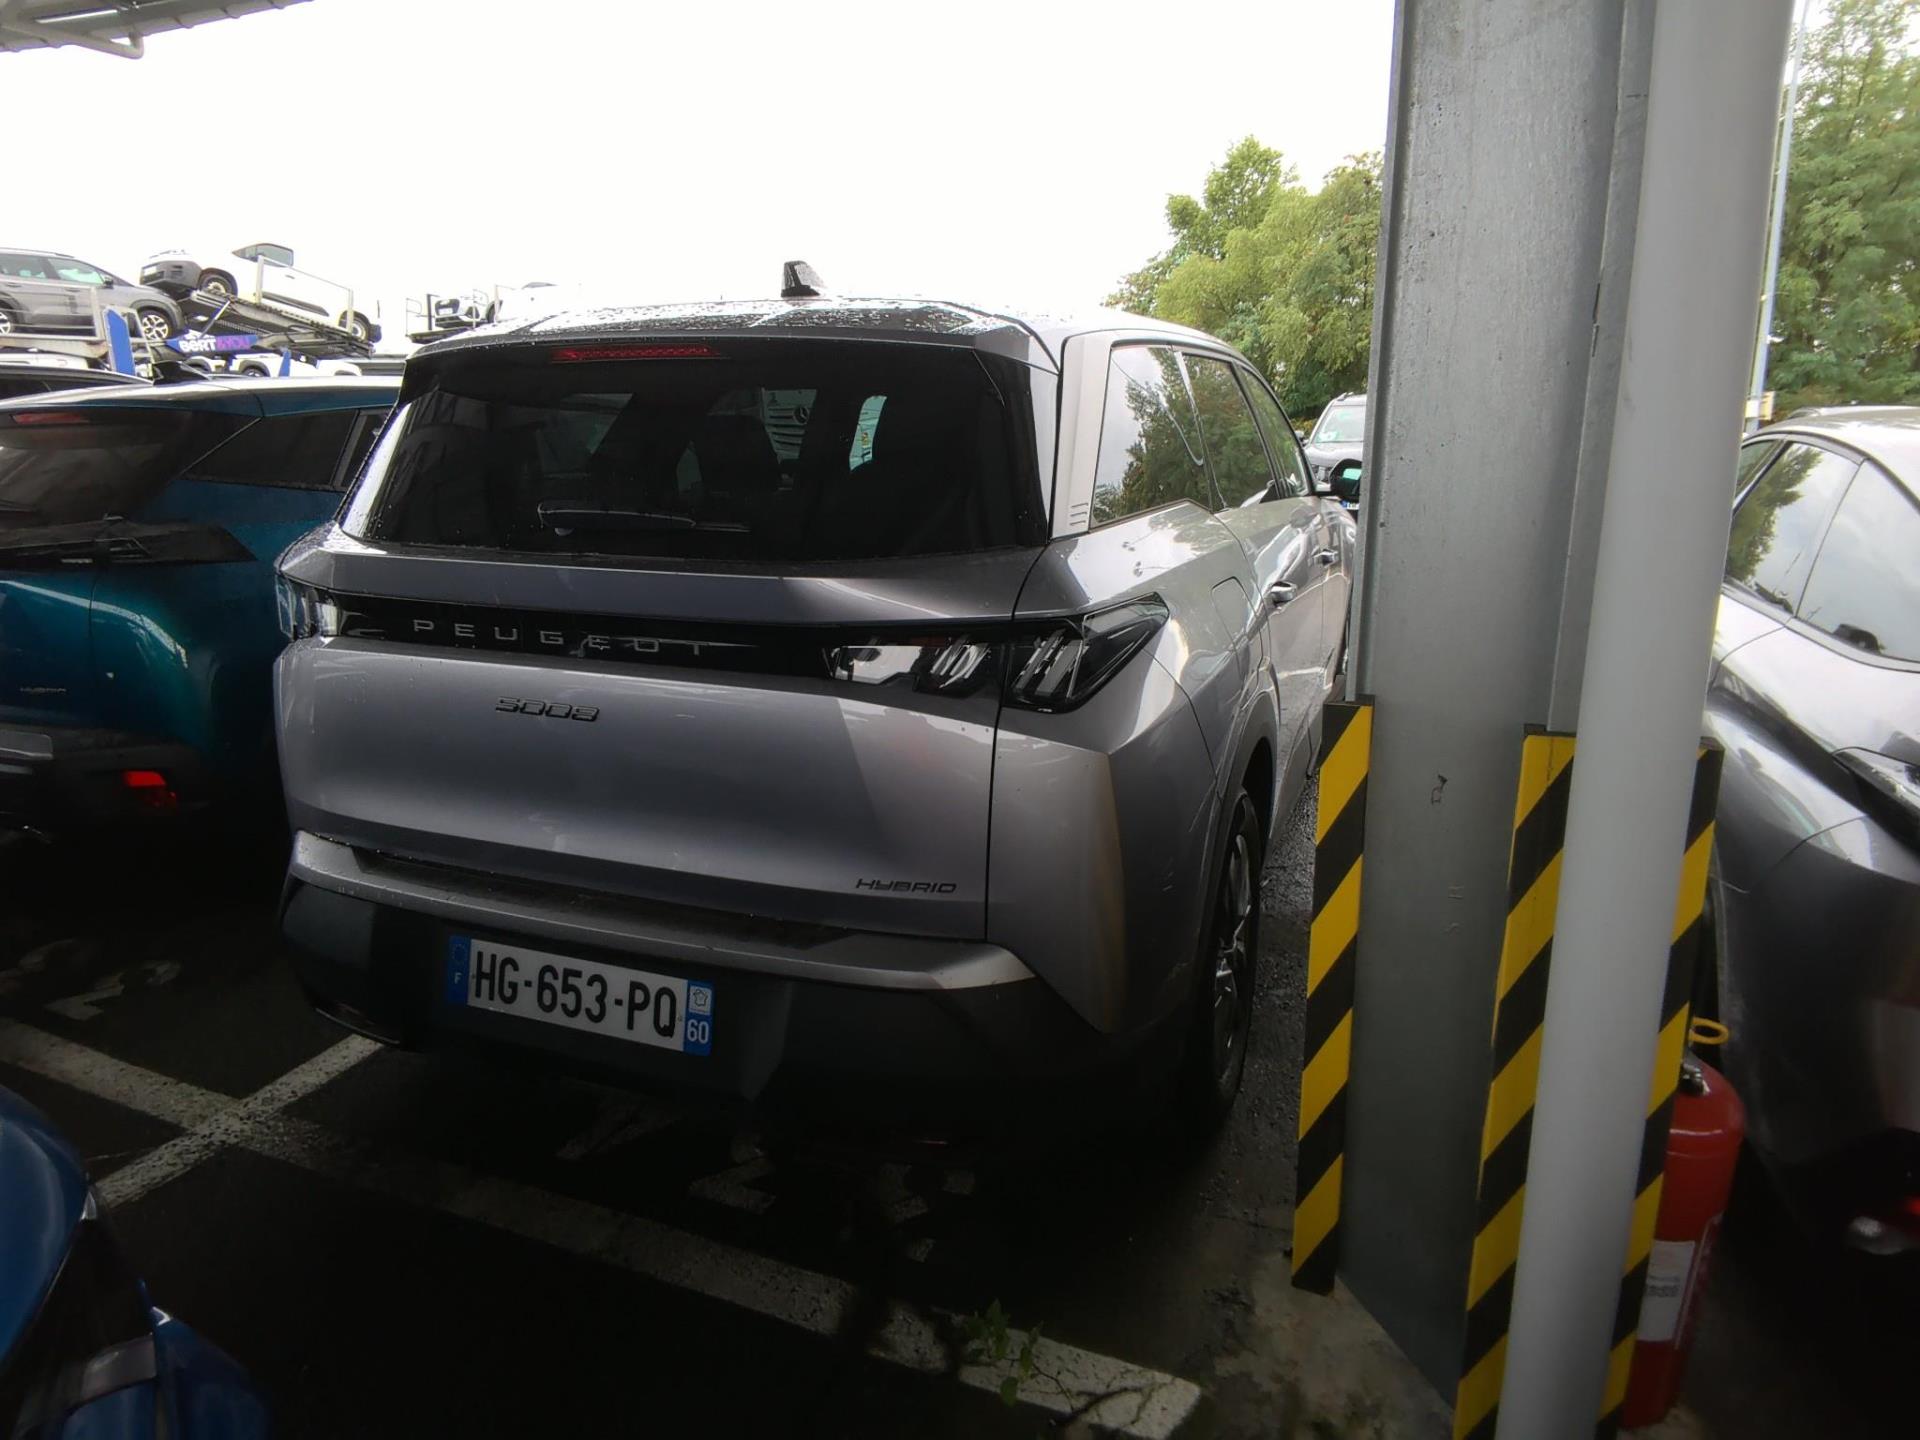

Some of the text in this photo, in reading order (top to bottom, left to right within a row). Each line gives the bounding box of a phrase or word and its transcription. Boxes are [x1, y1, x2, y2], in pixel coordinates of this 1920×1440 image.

[413, 619, 703, 656] PEUGEOT
[495, 697, 599, 722] 5008
[856, 878, 957, 893] HYBRID
[454, 972, 462, 984] F
[474, 951, 677, 1039] HG-653-PQ
[687, 1019, 709, 1043] 60
